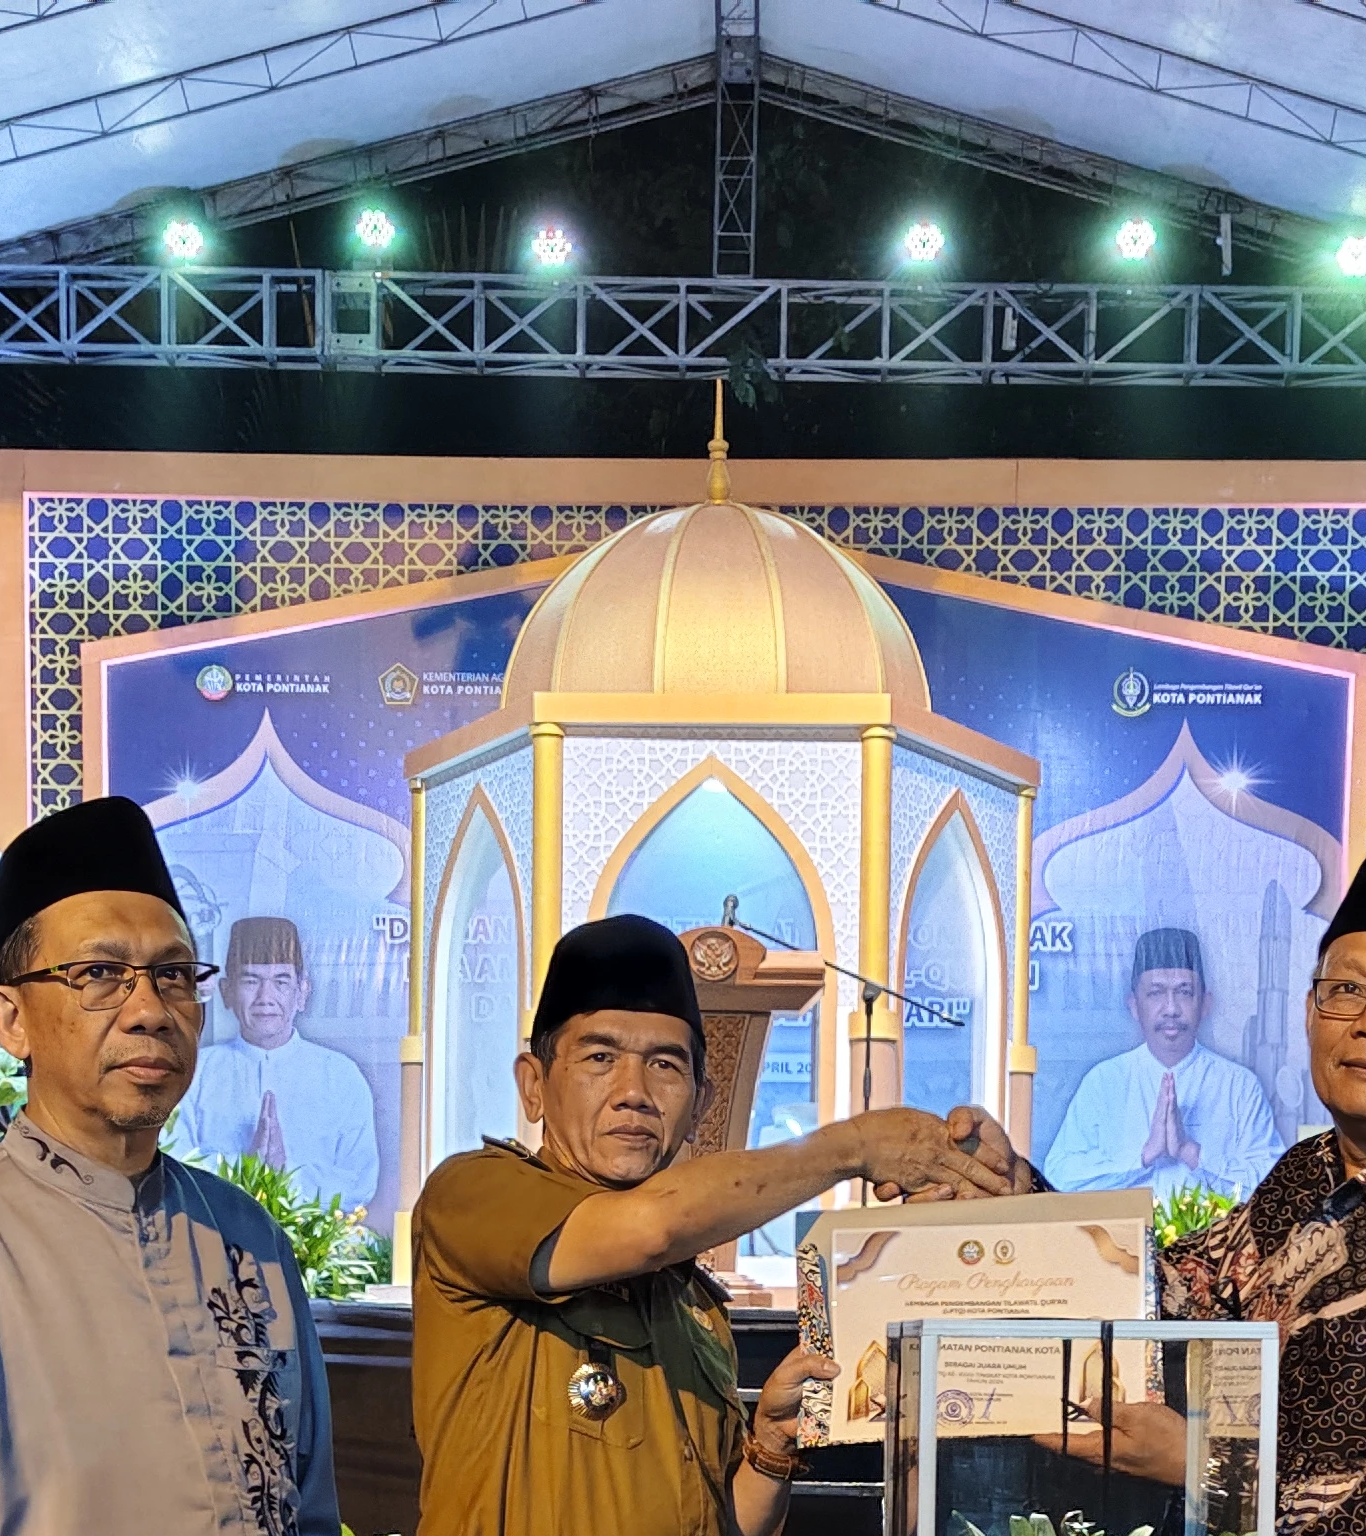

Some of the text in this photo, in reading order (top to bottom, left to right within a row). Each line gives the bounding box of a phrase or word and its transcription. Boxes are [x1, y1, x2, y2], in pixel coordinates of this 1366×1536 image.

[235, 673, 330, 682] PEMERINTAH
[423, 671, 504, 682] KEMENTERIAN AG
[236, 682, 330, 693] KOTA PONTIANAK
[423, 684, 502, 695] KOTA PONTIA
[1153, 692, 1262, 704] KOTA PONTIANAK
[966, 1271, 1076, 1296] Penghargaan
[974, 1345, 1033, 1354] PONTIANAK
[1034, 1346, 1061, 1355] KOTA
